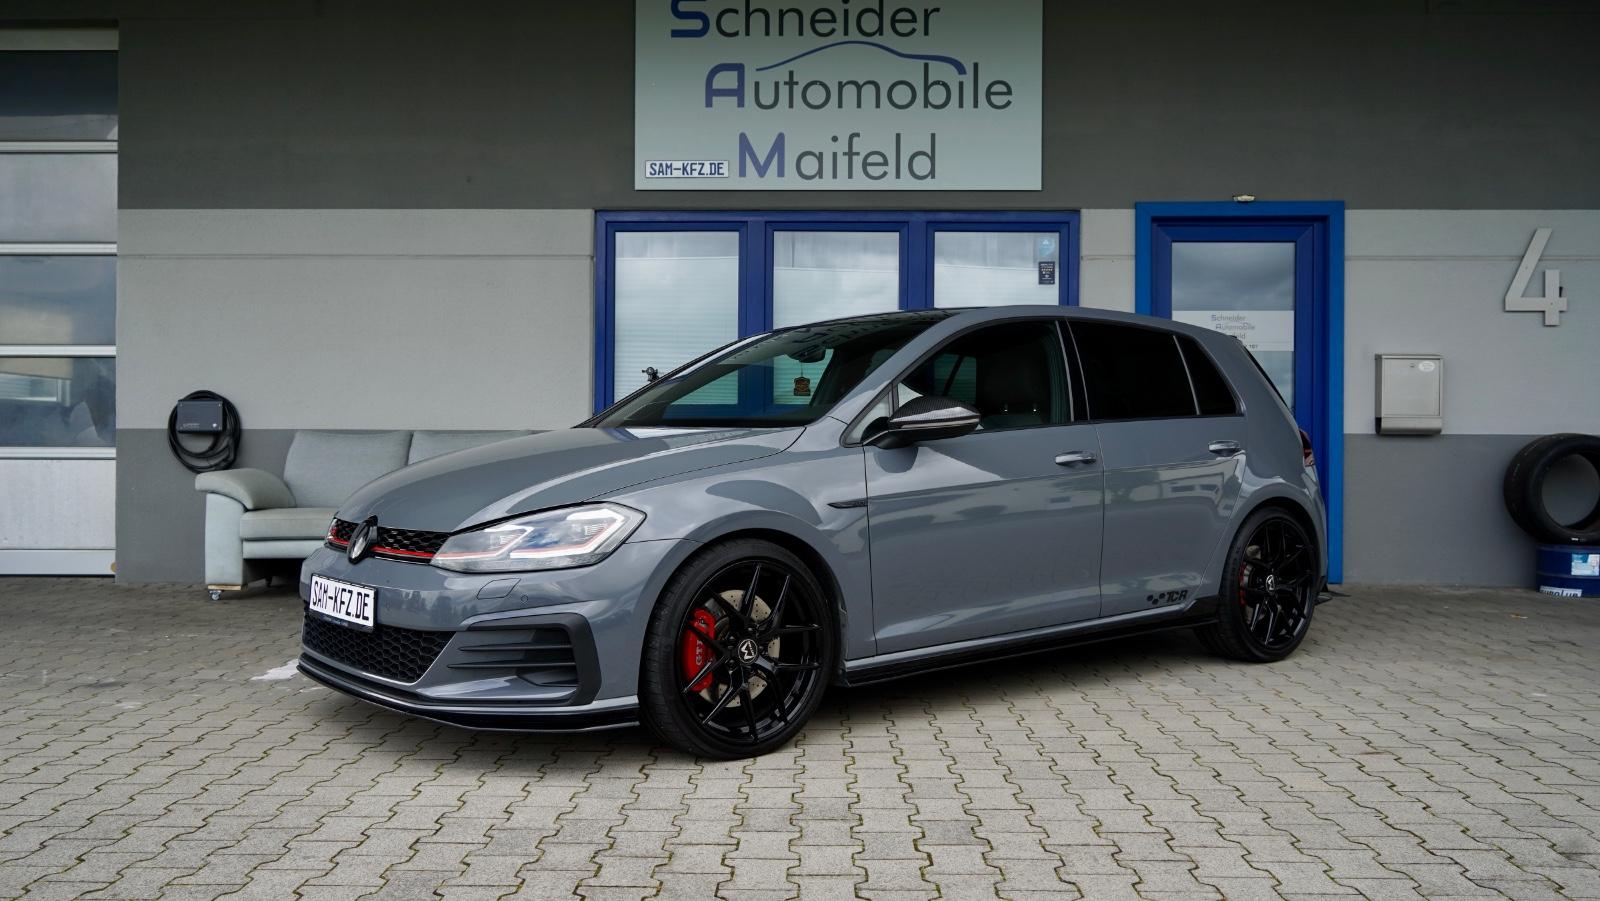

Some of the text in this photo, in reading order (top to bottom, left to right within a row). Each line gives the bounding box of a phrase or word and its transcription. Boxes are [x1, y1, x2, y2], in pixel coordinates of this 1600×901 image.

[670, 0, 941, 38] Schneider
[704, 62, 1013, 110] Automobile
[649, 161, 725, 177] SAM-KFZ.DE
[738, 132, 936, 181] Maifeld
[1504, 228, 1567, 326] 4
[312, 580, 370, 621] SAM-KFZ.DE
